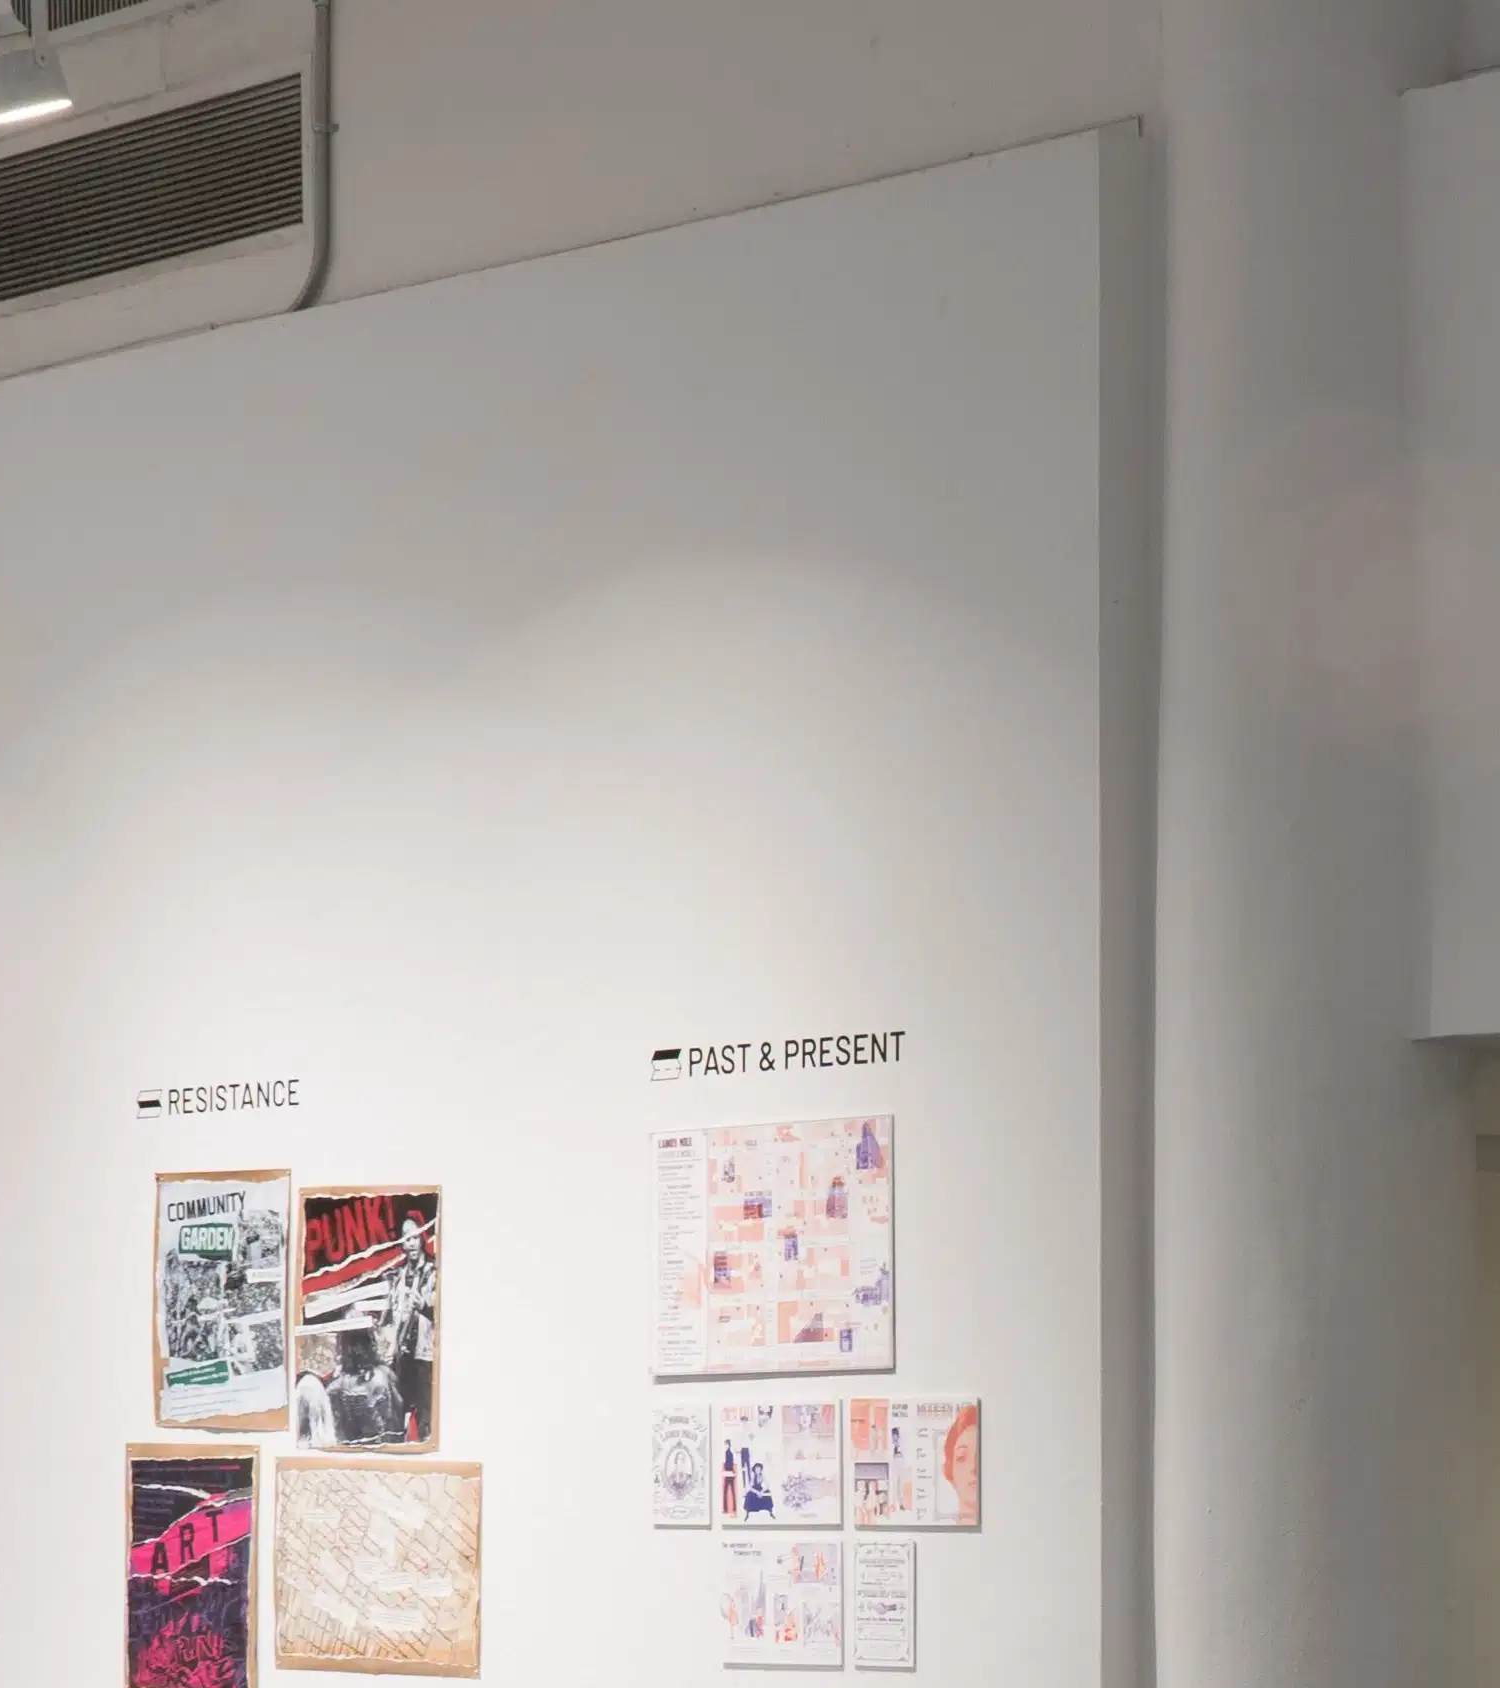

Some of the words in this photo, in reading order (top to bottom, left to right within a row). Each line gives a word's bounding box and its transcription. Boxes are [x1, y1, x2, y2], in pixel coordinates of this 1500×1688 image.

[687, 1042, 751, 1077] PAST
[759, 1041, 775, 1072] &
[784, 1031, 906, 1070] PRESENT
[168, 1079, 301, 1116] RESISTANCE
[167, 1190, 247, 1222] COMMUNITY
[180, 1225, 235, 1251] GARDEN
[305, 1195, 396, 1271] PUNK!
[151, 1509, 224, 1576] ART
